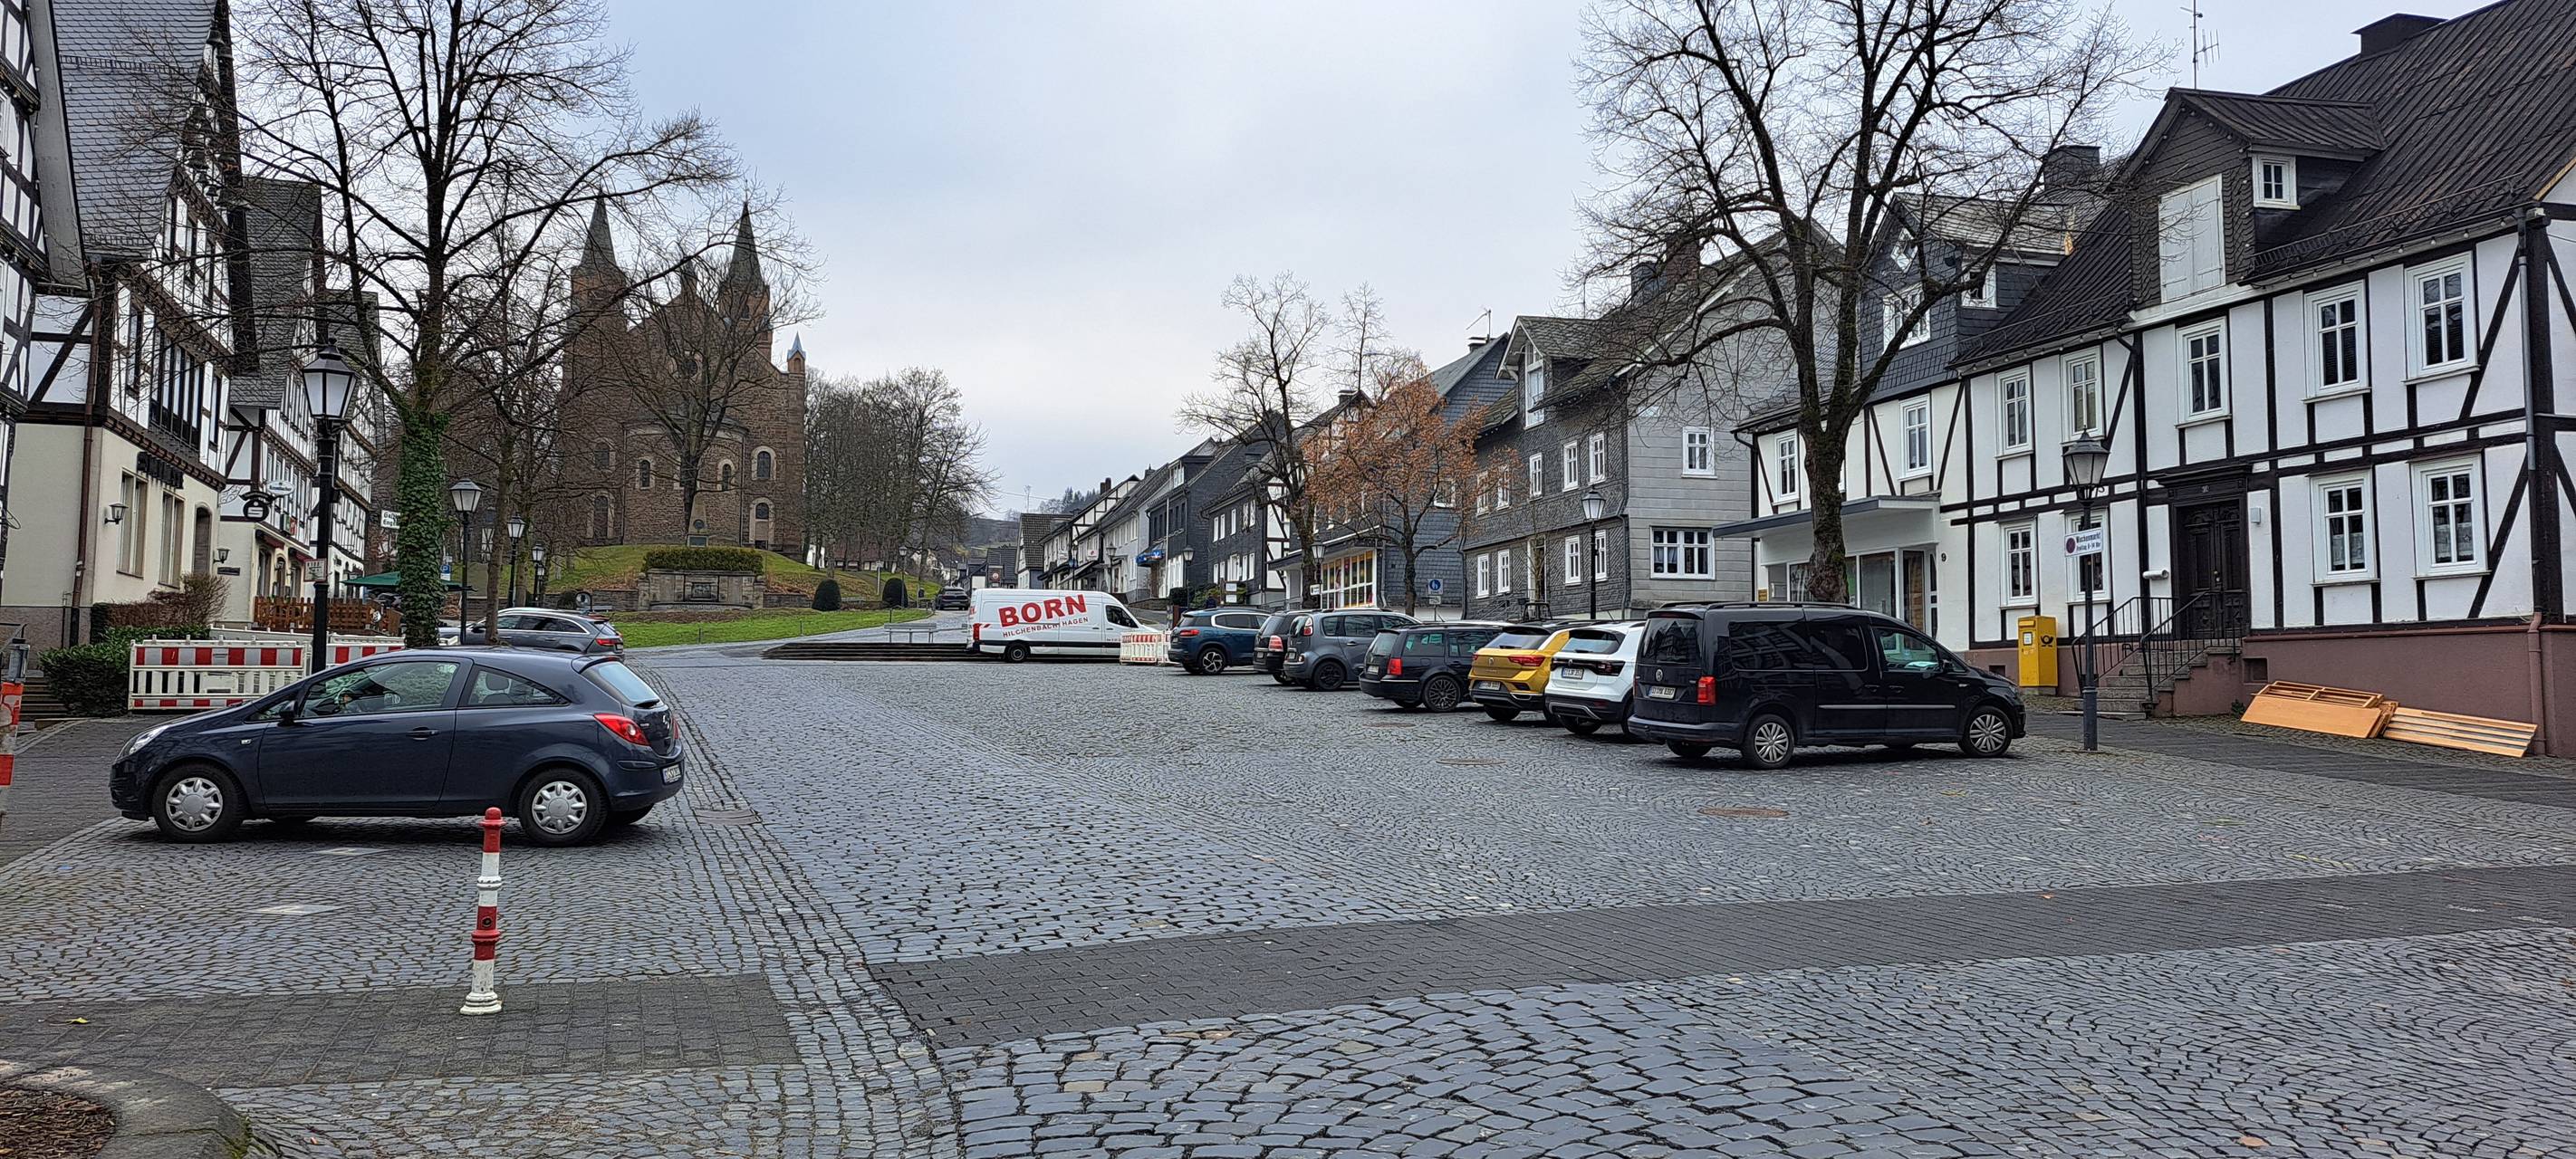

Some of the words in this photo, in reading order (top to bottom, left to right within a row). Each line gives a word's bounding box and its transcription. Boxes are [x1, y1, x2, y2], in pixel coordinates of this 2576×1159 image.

[1940, 552, 1947, 562] 9
[998, 594, 1087, 627] BORN
[1003, 622, 1060, 638] HILCHENBACH
[1062, 617, 1089, 627] HAGEN
